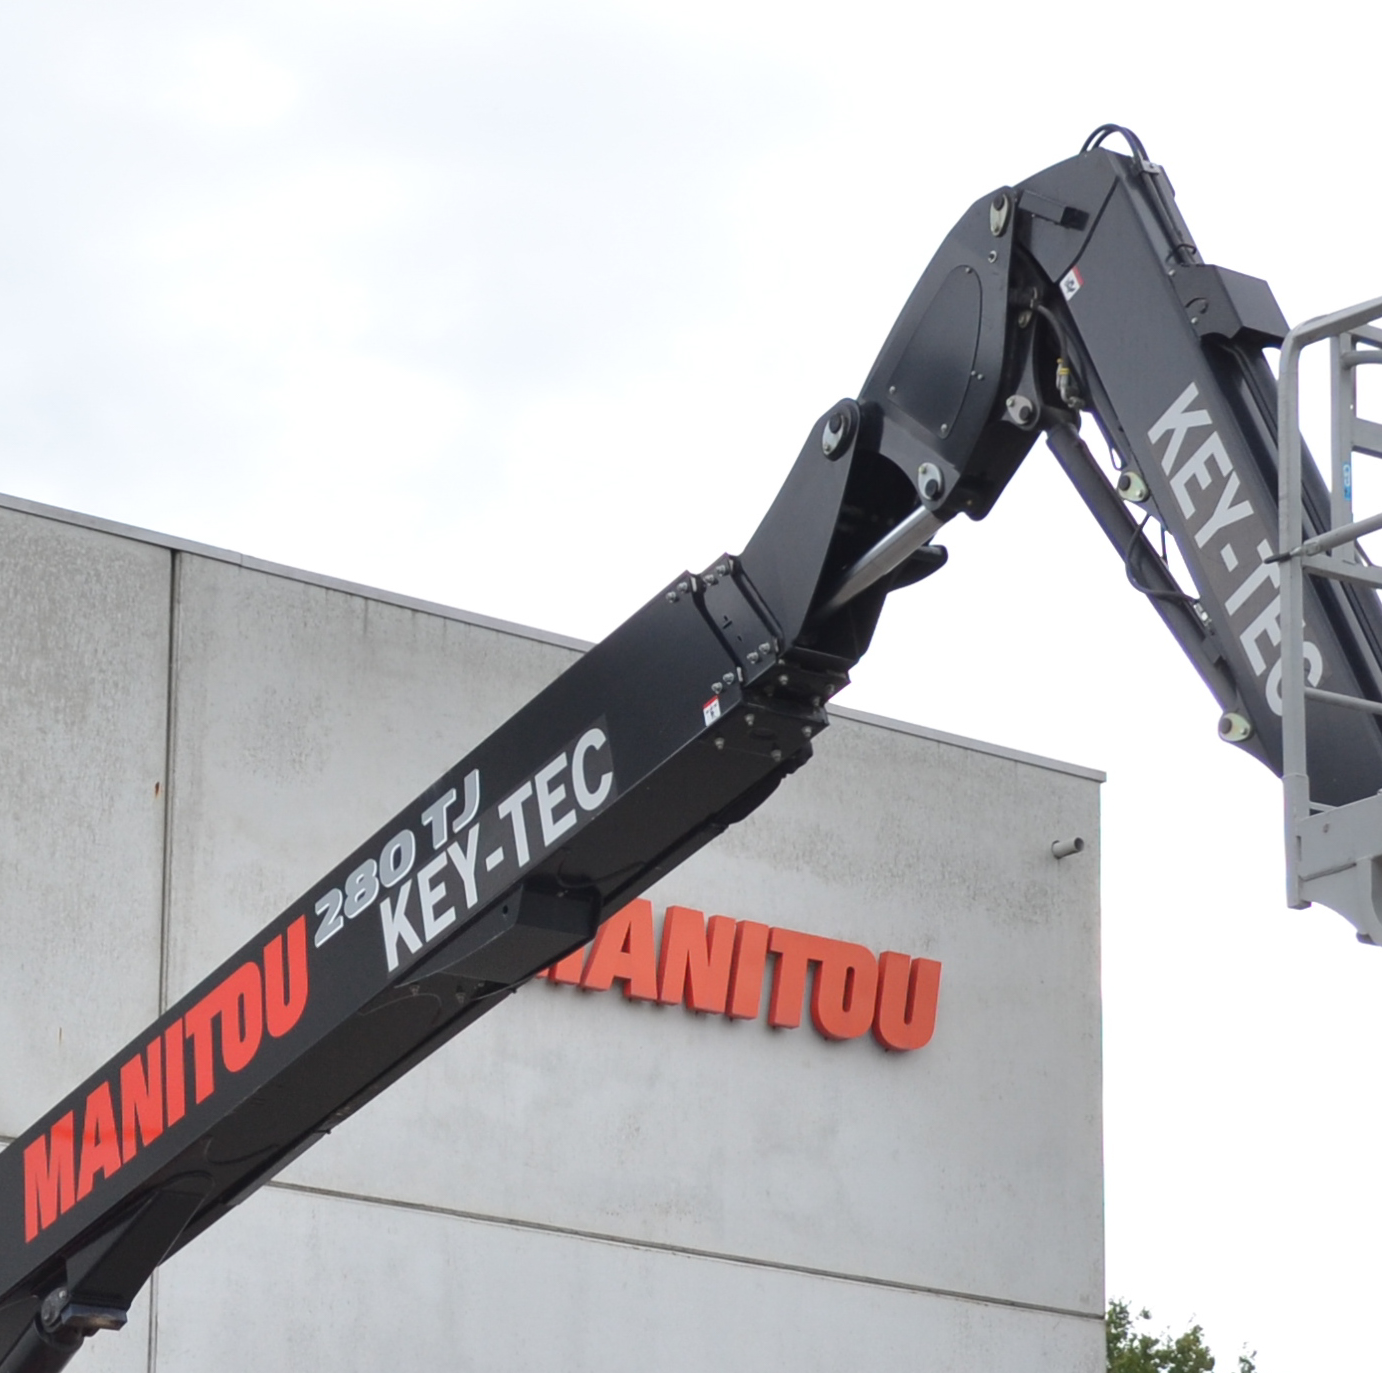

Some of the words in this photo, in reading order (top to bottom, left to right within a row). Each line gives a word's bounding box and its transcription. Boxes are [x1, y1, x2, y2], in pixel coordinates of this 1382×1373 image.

[1147, 381, 1324, 717] KEY-TEC
[315, 829, 416, 947] 280
[421, 769, 480, 850] TJ
[379, 728, 614, 972] KEY-TEC
[23, 913, 308, 1244] MANITOU
[538, 897, 942, 1051] ANITOU
